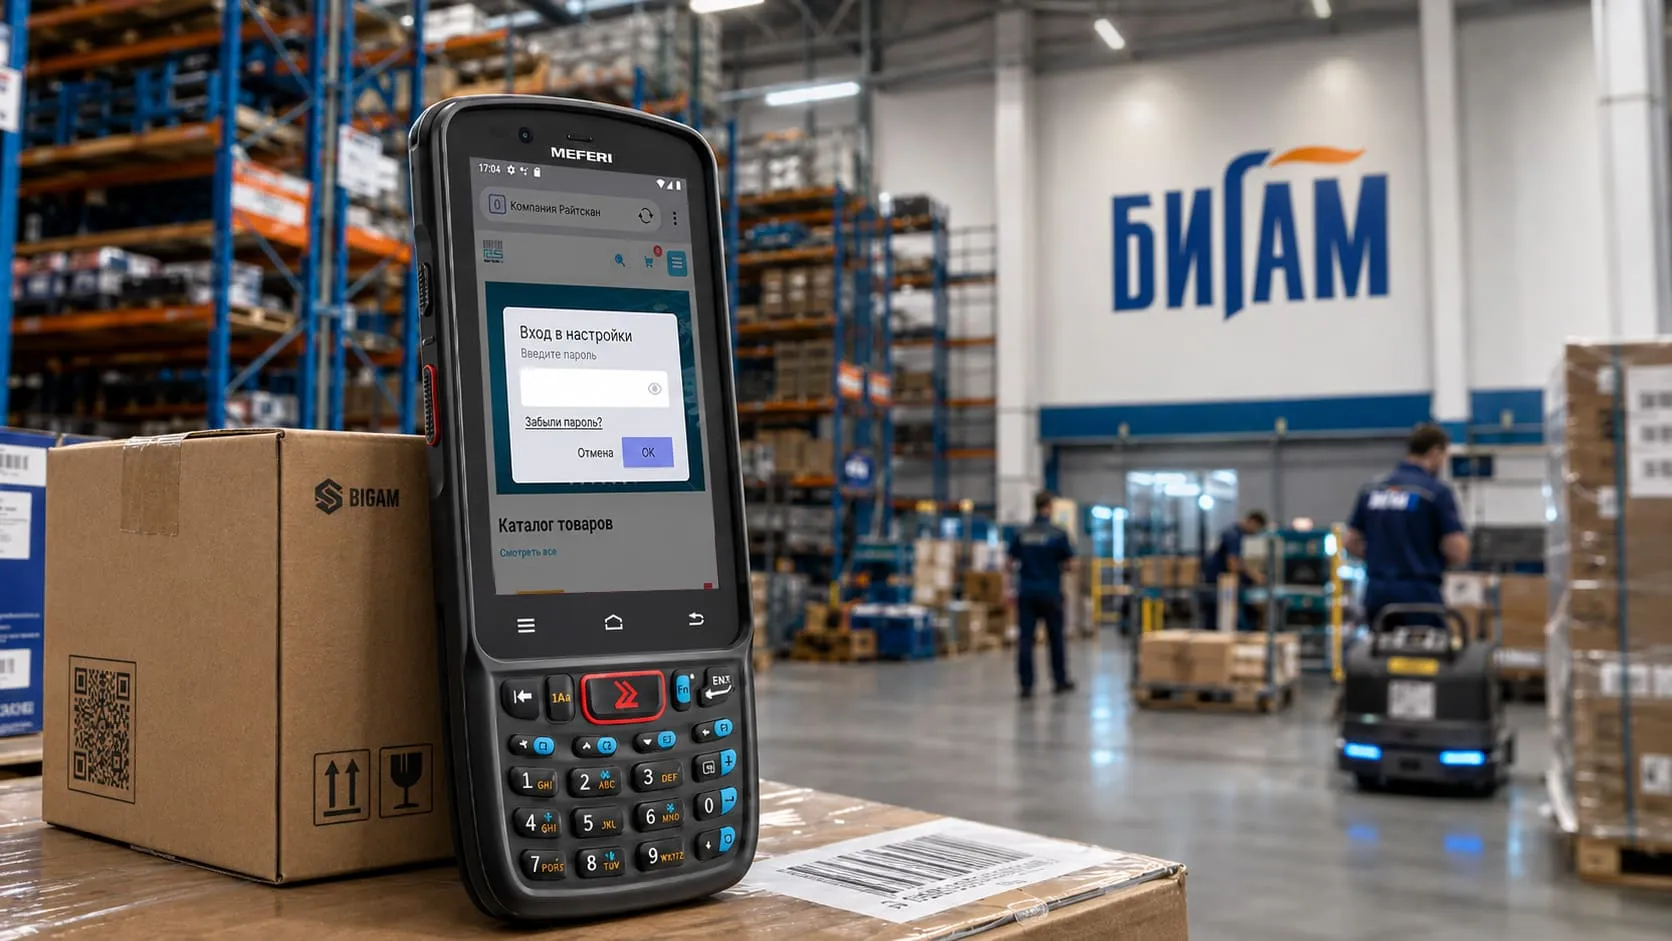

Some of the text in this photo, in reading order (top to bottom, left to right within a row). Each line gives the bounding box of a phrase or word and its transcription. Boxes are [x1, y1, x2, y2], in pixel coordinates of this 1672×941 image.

[550, 146, 613, 164] MEFERI
[478, 163, 500, 174] 17:04
[510, 201, 601, 217] Компания Райтскан
[1111, 148, 1390, 322] БИГАМ
[519, 325, 633, 345] Вход в настройки
[520, 347, 598, 362] Введите пароль
[525, 416, 603, 429] Забыли пароль?
[577, 447, 614, 459] Отмена
[641, 447, 656, 458] OK
[349, 488, 400, 508] BIGAM
[498, 518, 614, 534] Каталог товаров
[500, 548, 541, 559] Смотреть
[677, 684, 689, 695] Fn
[522, 771, 553, 790] 1 GHI
[580, 773, 616, 791] 2 ABC
[643, 768, 678, 785] 3 DEF
[704, 797, 714, 814] 0
[525, 813, 557, 834] 4 GHI
[583, 814, 594, 832] 5
[646, 808, 656, 825] 6
[530, 855, 540, 873] 7
[587, 854, 597, 871] 8
[648, 847, 658, 864] 9
